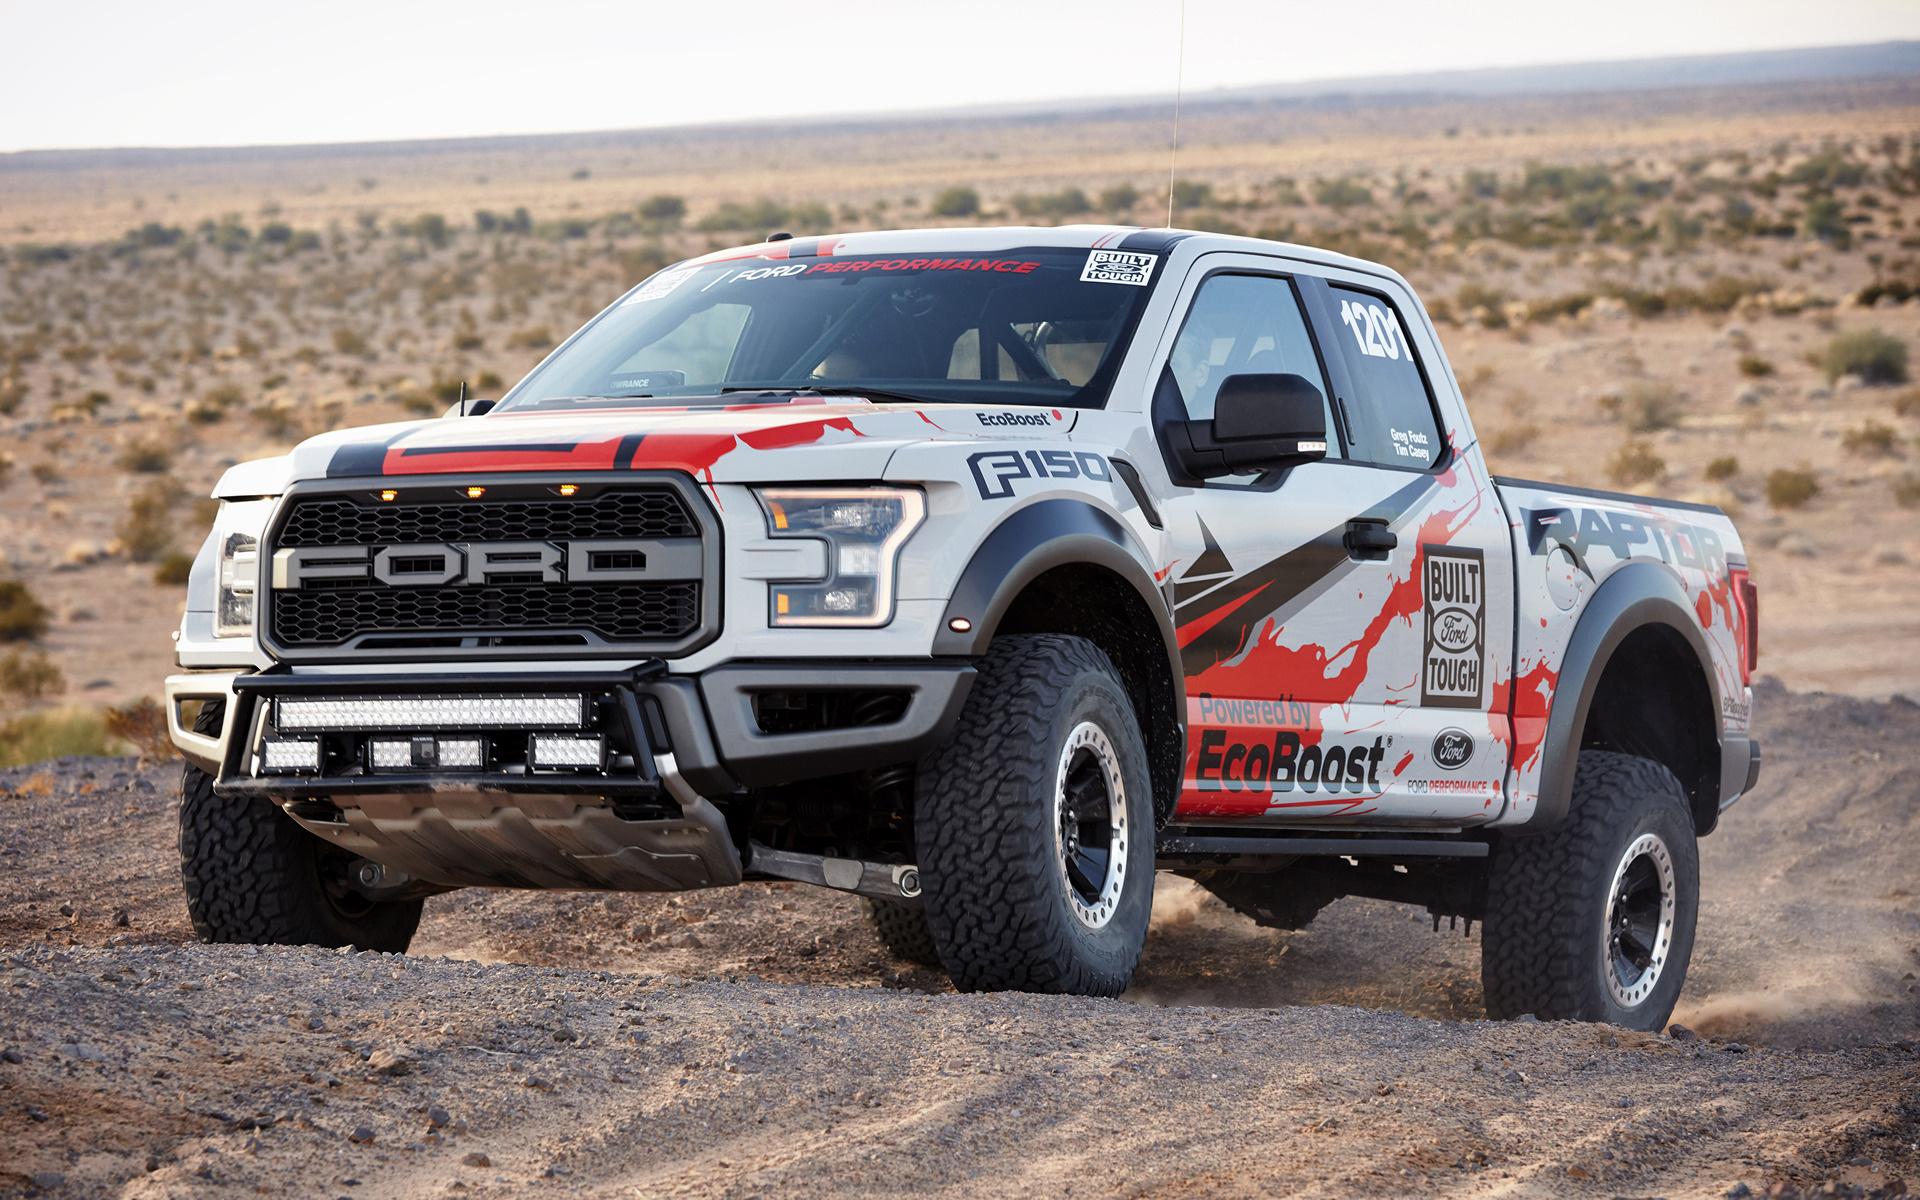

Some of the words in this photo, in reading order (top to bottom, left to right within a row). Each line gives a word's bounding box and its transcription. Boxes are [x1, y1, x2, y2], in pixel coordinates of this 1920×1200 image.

[734, 264, 807, 284] FORD
[804, 261, 1041, 276] PERFORMANCE
[1095, 253, 1150, 266] BUILT
[1089, 271, 1143, 282] TOUGH
[1341, 300, 1413, 362] 1201
[1390, 427, 1408, 445] Greg
[1393, 443, 1408, 456] Tim
[1409, 444, 1429, 461] Casey
[1520, 507, 1726, 584] RAPTOR
[273, 541, 703, 589] FORD
[1430, 561, 1479, 604] BUILT
[1440, 615, 1469, 644] Ford
[1429, 657, 1478, 692] TOUGH
[1200, 692, 1288, 725] Powered
[1289, 694, 1311, 732] by
[1440, 735, 1467, 760] Ford
[1408, 780, 1428, 793] FORD
[1429, 781, 1487, 793] PERFORMANCE
